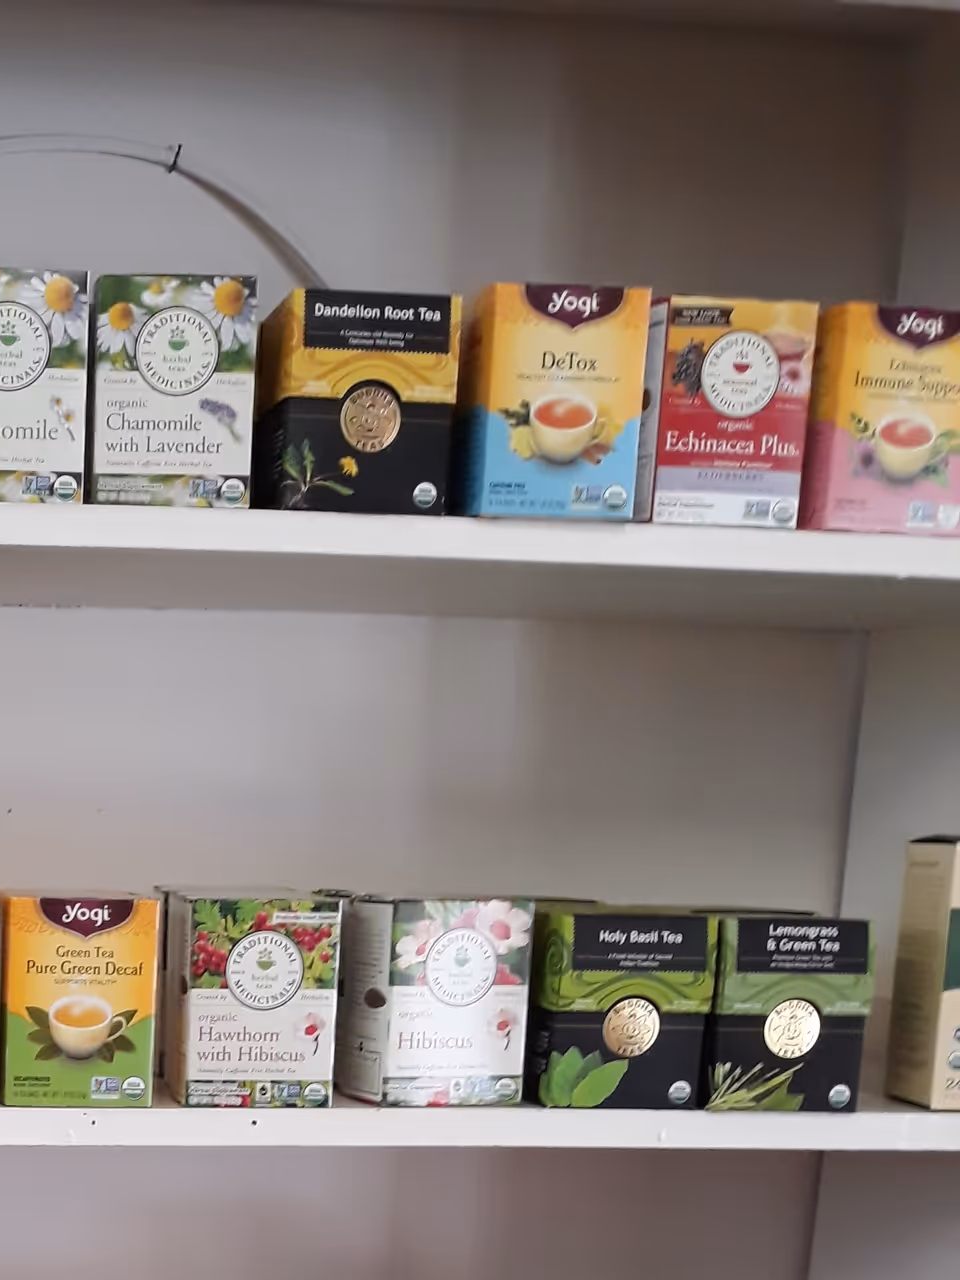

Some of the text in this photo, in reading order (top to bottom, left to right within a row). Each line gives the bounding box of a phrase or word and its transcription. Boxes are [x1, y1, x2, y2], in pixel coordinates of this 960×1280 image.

[315, 303, 441, 321] Dandelion Root Tea
[143, 313, 213, 346] TRADITIONAL
[541, 351, 598, 371] DeTox
[144, 360, 212, 390] MEDICINALS
[107, 398, 148, 410] organic
[106, 413, 202, 431] Chamomile
[106, 436, 223, 454] with Lavender
[665, 431, 795, 456] Echinacea Plus
[599, 930, 683, 945] Holy Basil Tea
[769, 924, 839, 939] Lemongrass
[56, 945, 114, 958] Green Tea
[233, 935, 298, 965] TRADITIONAL
[780, 939, 817, 951] Green
[819, 940, 840, 952] Tea
[26, 960, 145, 976] Pure Green Decaf
[233, 977, 297, 1005] MEDICINALS
[198, 1013, 238, 1024] organic
[198, 1026, 280, 1042] Hawthorn
[398, 1032, 473, 1050] Hibiscus
[197, 1046, 305, 1062] with Hibiscus
